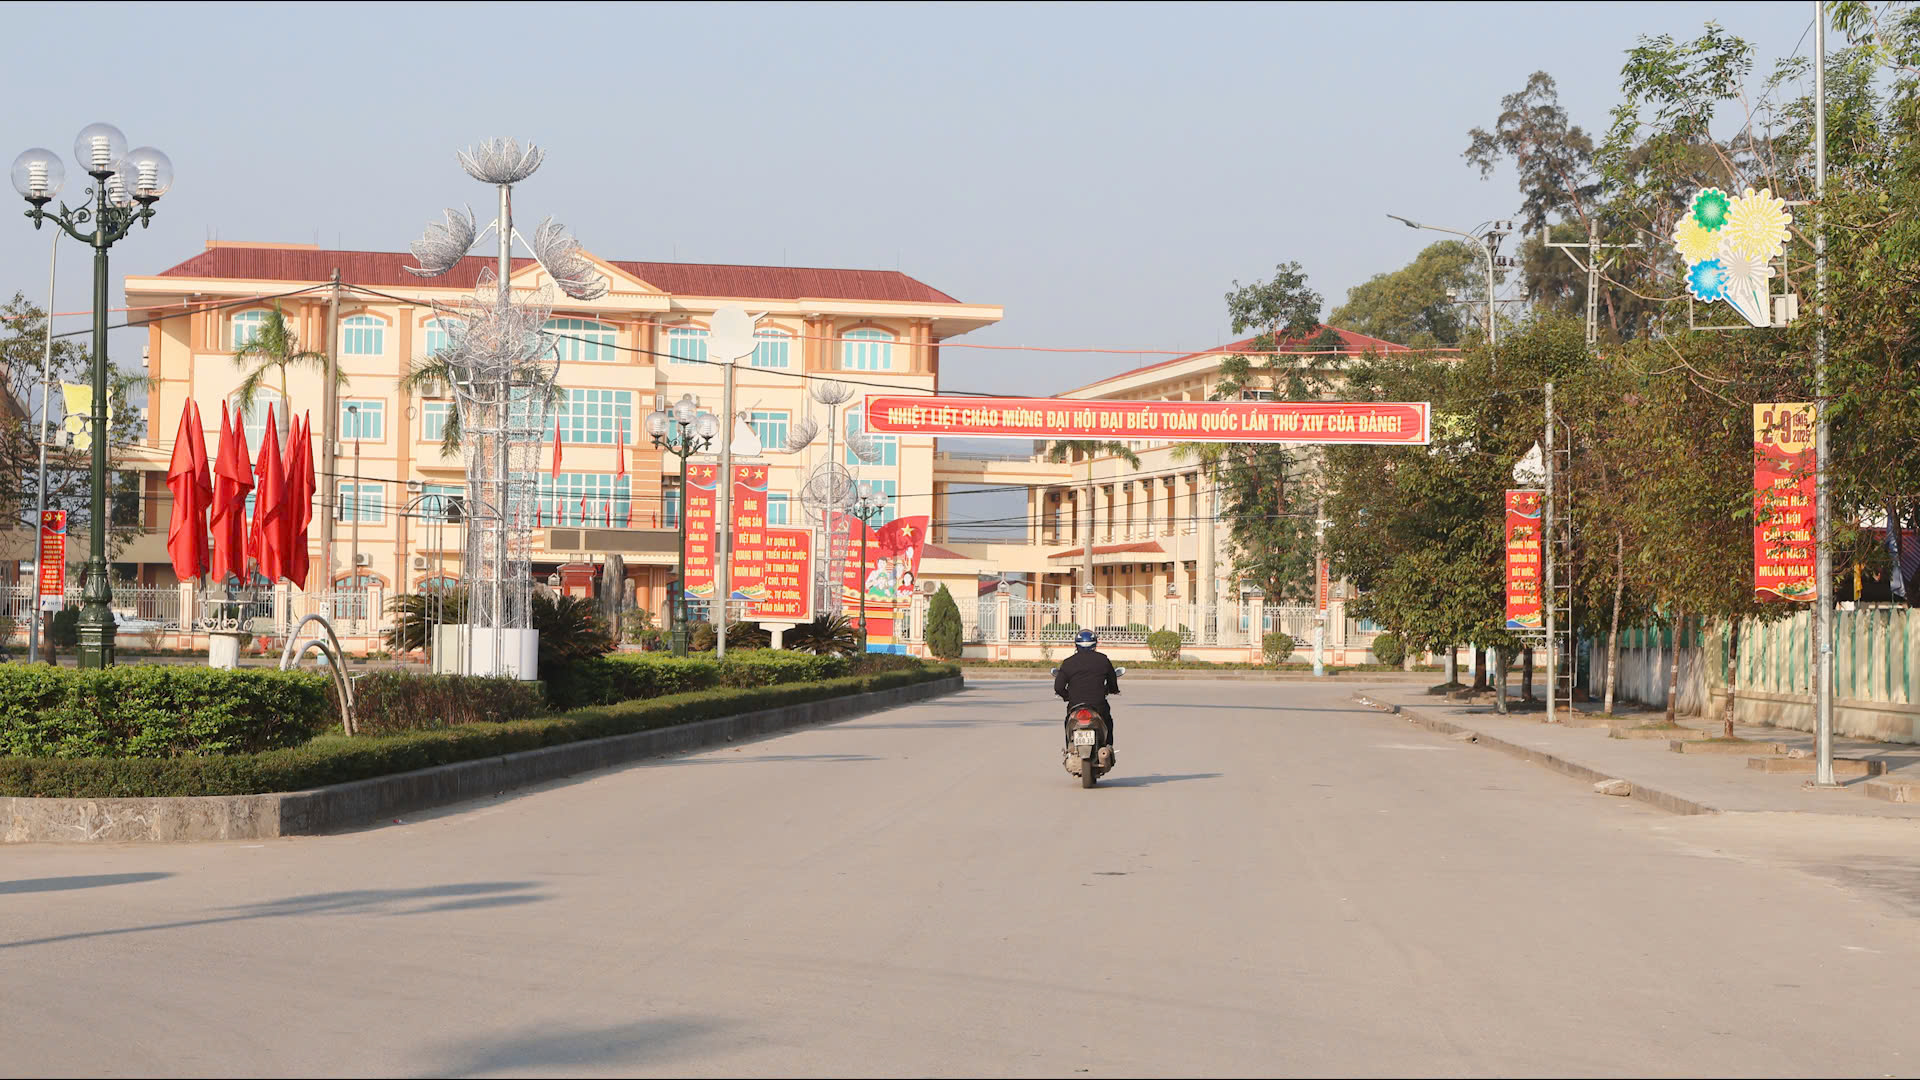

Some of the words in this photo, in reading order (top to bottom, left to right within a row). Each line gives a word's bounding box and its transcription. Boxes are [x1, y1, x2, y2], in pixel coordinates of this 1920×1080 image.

[889, 405, 928, 429] NHIỆT
[931, 405, 959, 429] LIỆT
[962, 406, 999, 427] CHÀO
[1003, 407, 1043, 428] MỪNG
[1047, 411, 1070, 431] ĐẠI
[1074, 408, 1096, 431] HỘI
[1101, 412, 1123, 432] ĐẠI
[1127, 406, 1158, 430] BIỂU
[1161, 410, 1197, 431] TOÀN
[1201, 408, 1237, 432] QUỐC
[1242, 409, 1269, 431] LẦN
[1272, 411, 1299, 431] THỨ
[1302, 415, 1325, 432] XIV
[1328, 410, 1356, 432] CỦA
[1359, 410, 1402, 432] ĐẢNG!
[1793, 413, 1808, 427] 1945
[1793, 430, 1810, 443] 2025
[1786, 511, 1801, 526] HỘI
[739, 531, 749, 546] VIỆT
[1759, 564, 1786, 576] MUÔN
[1788, 564, 1808, 576] NĂM
